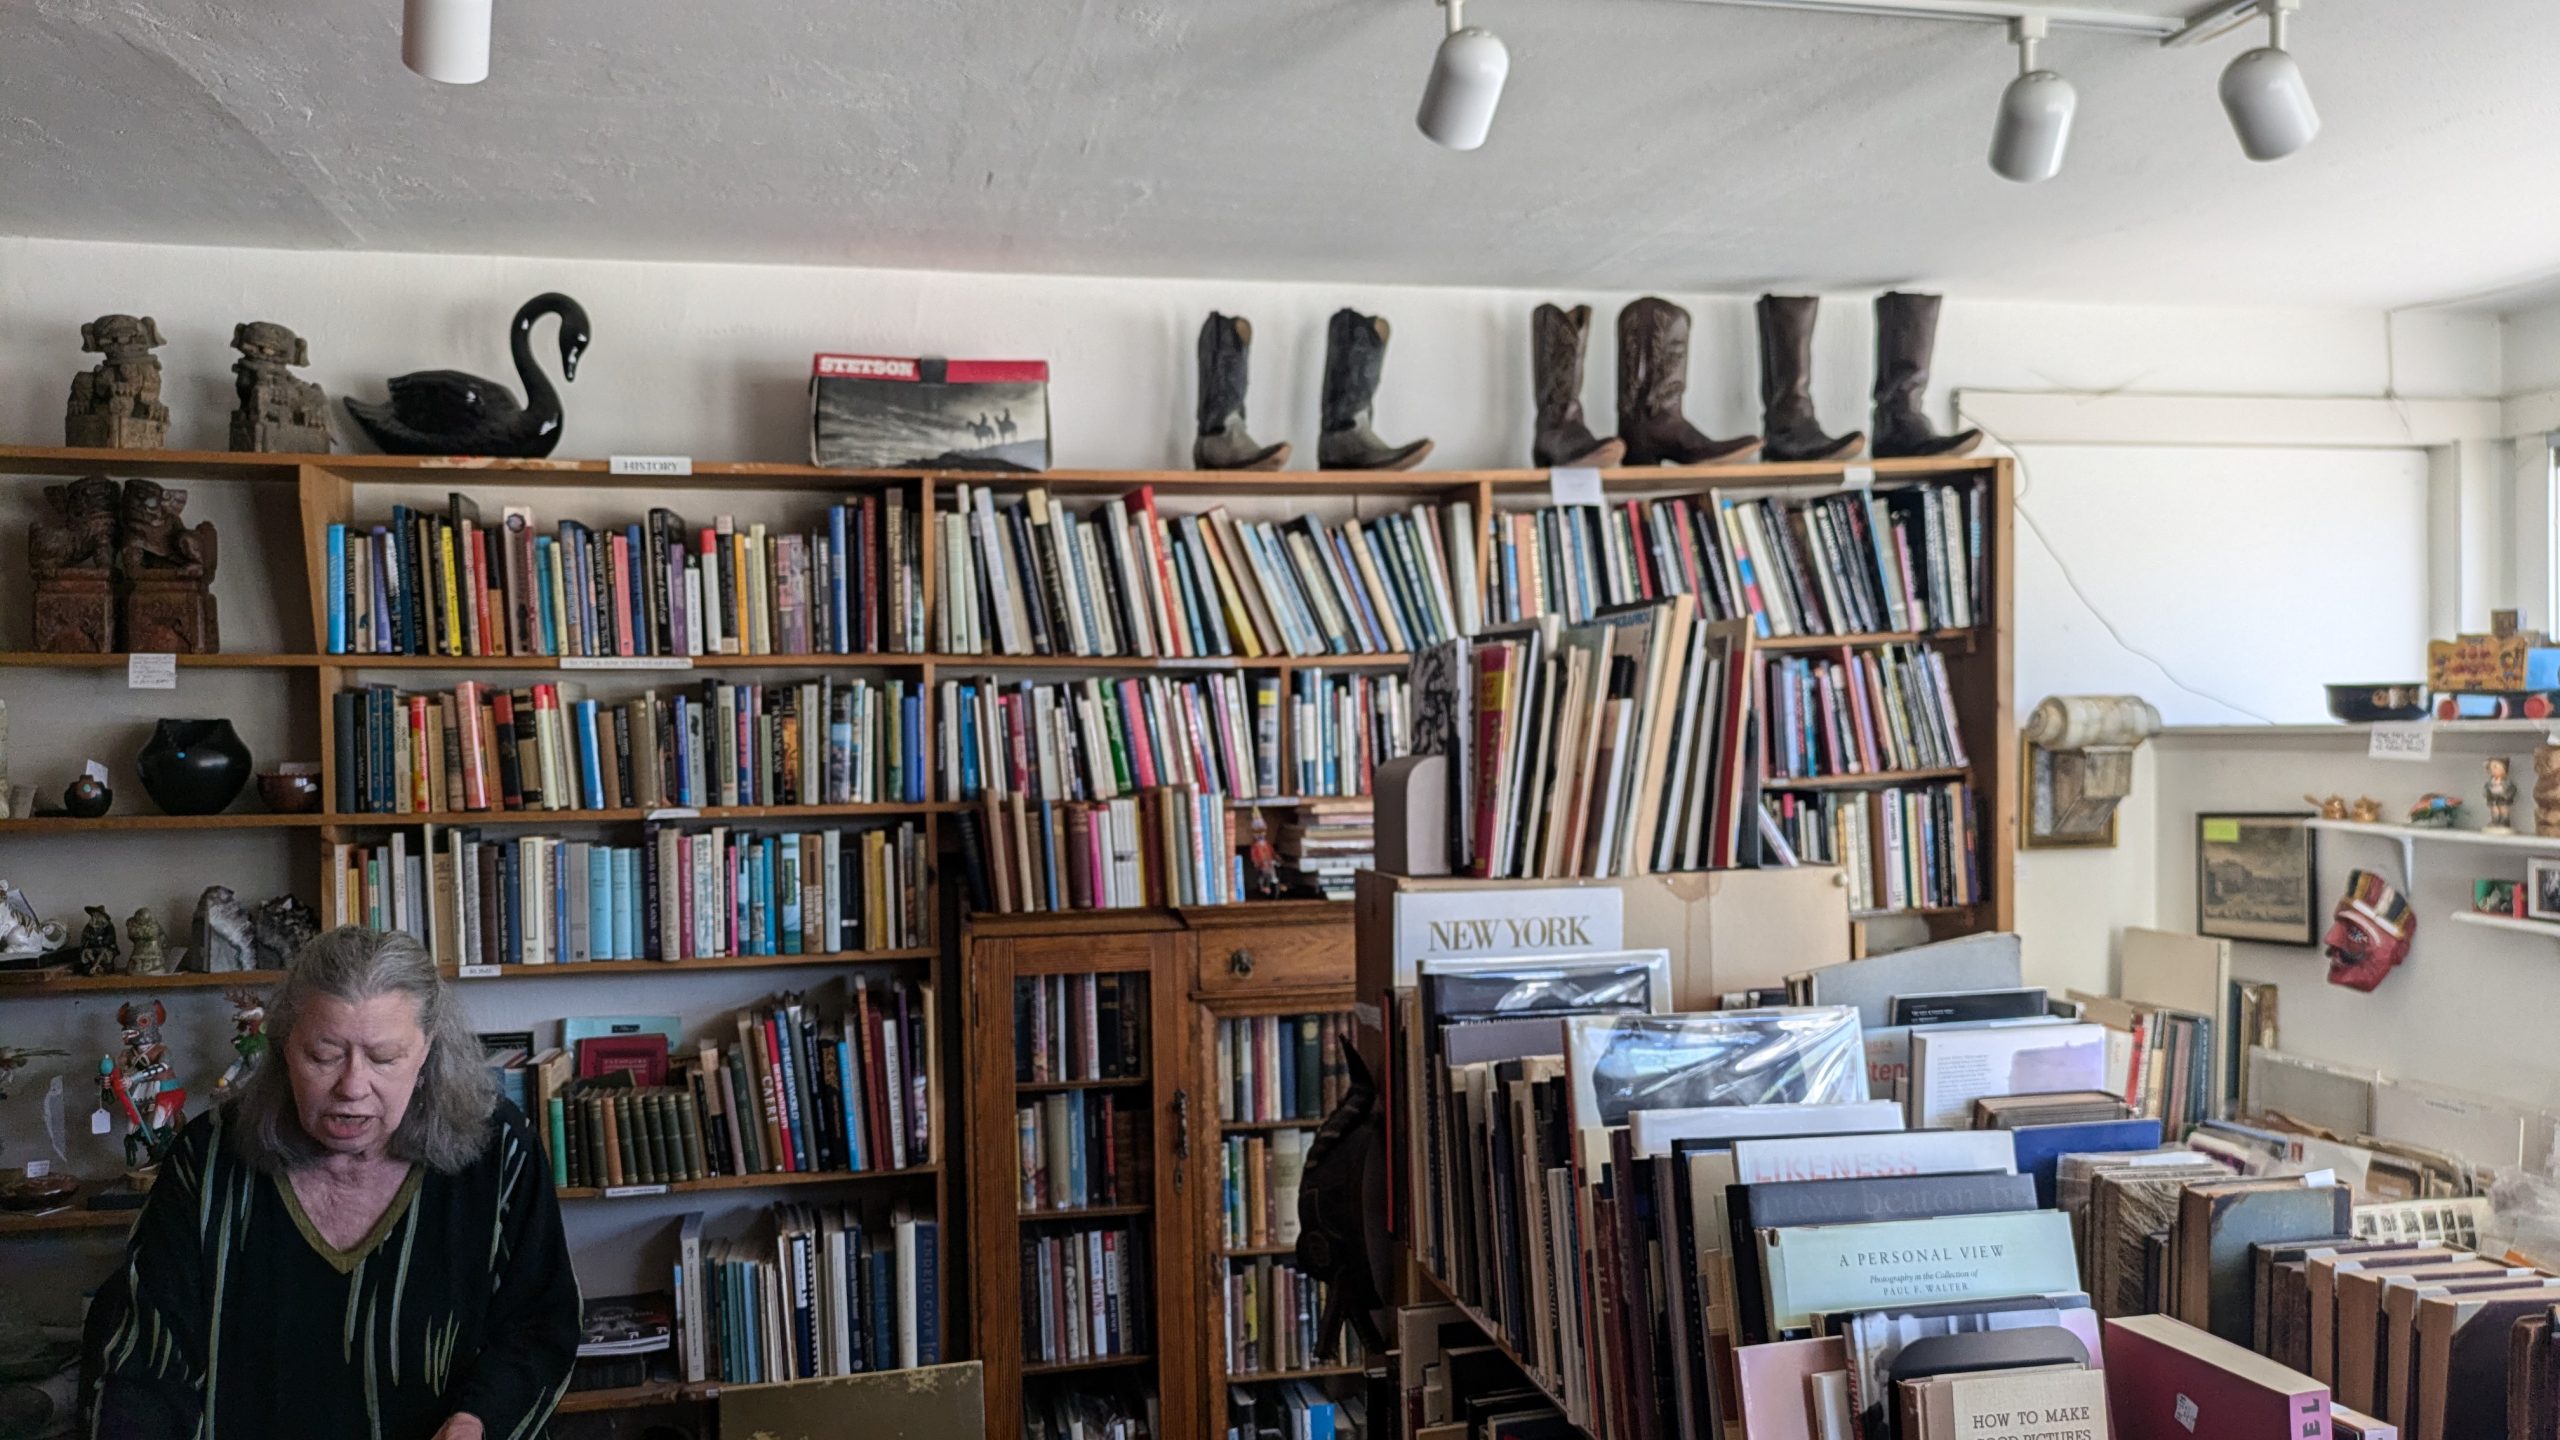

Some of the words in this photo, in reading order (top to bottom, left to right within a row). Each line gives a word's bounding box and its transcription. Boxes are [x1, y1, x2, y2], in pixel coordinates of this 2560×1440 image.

[820, 357, 915, 376] STETSON
[623, 461, 679, 472] HISTORY
[1428, 918, 1501, 951] NEW
[1506, 915, 1593, 948] YORK
[761, 1075, 778, 1125] CAERE
[1753, 1152, 1919, 1183] LIKENESS
[1839, 1254, 1849, 1267] A
[1857, 1247, 1953, 1267] PERSONAL
[1959, 1244, 2004, 1260] VIEW
[1869, 1272, 1914, 1285] Photography
[1914, 1273, 1922, 1281] in
[1923, 1272, 1934, 1281] the
[1935, 1270, 1968, 1280] Collection
[1969, 1269, 1979, 1279] of
[1883, 1286, 1910, 1297] PAUL
[1914, 1285, 1922, 1294] F.
[1926, 1282, 1969, 1294] WALTER
[922, 1299, 935, 1338] CAVE
[1972, 1413, 2010, 1429] HOW
[2017, 1410, 2039, 1425] TO
[2045, 1406, 2091, 1423] MAKE
